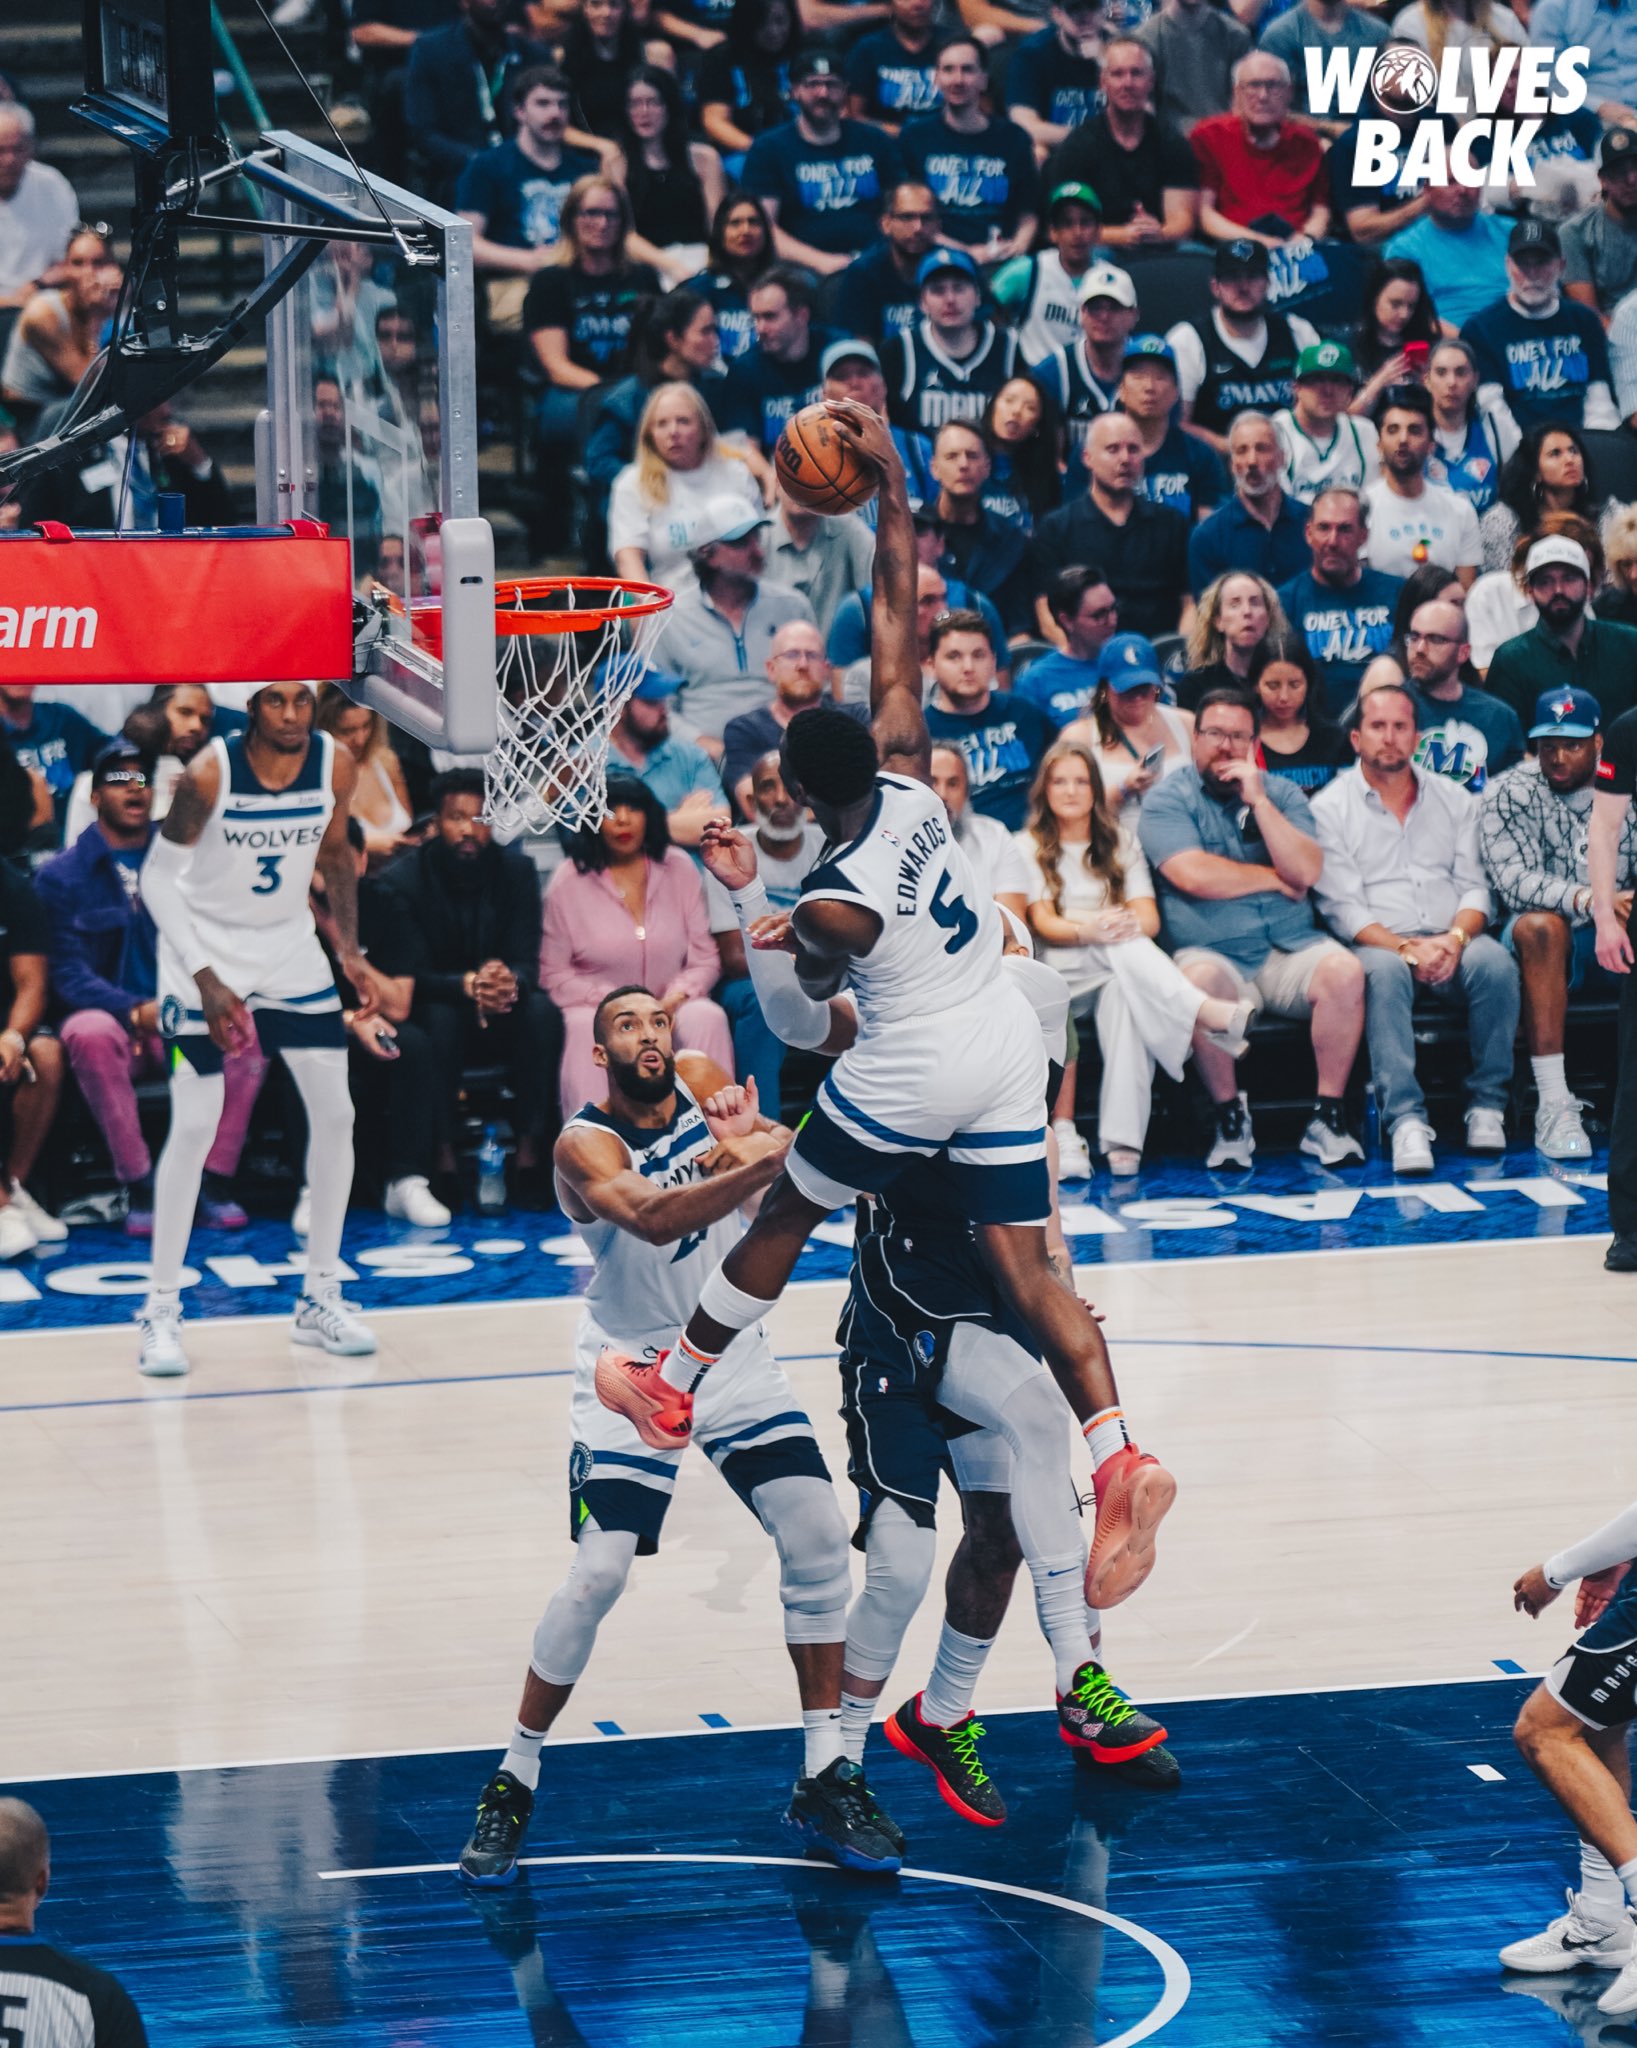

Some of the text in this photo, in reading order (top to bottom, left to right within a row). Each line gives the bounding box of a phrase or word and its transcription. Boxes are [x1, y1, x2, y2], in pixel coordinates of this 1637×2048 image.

[1553, 334, 1581, 358] FOR
[1525, 358, 1568, 392] ALL
[1355, 605, 1390, 629] FOR
[1323, 627, 1373, 662] ALL
[223, 826, 323, 848] WOLVES
[252, 855, 286, 895] 3
[897, 817, 947, 916] EDWARDS
[929, 867, 979, 955] 5
